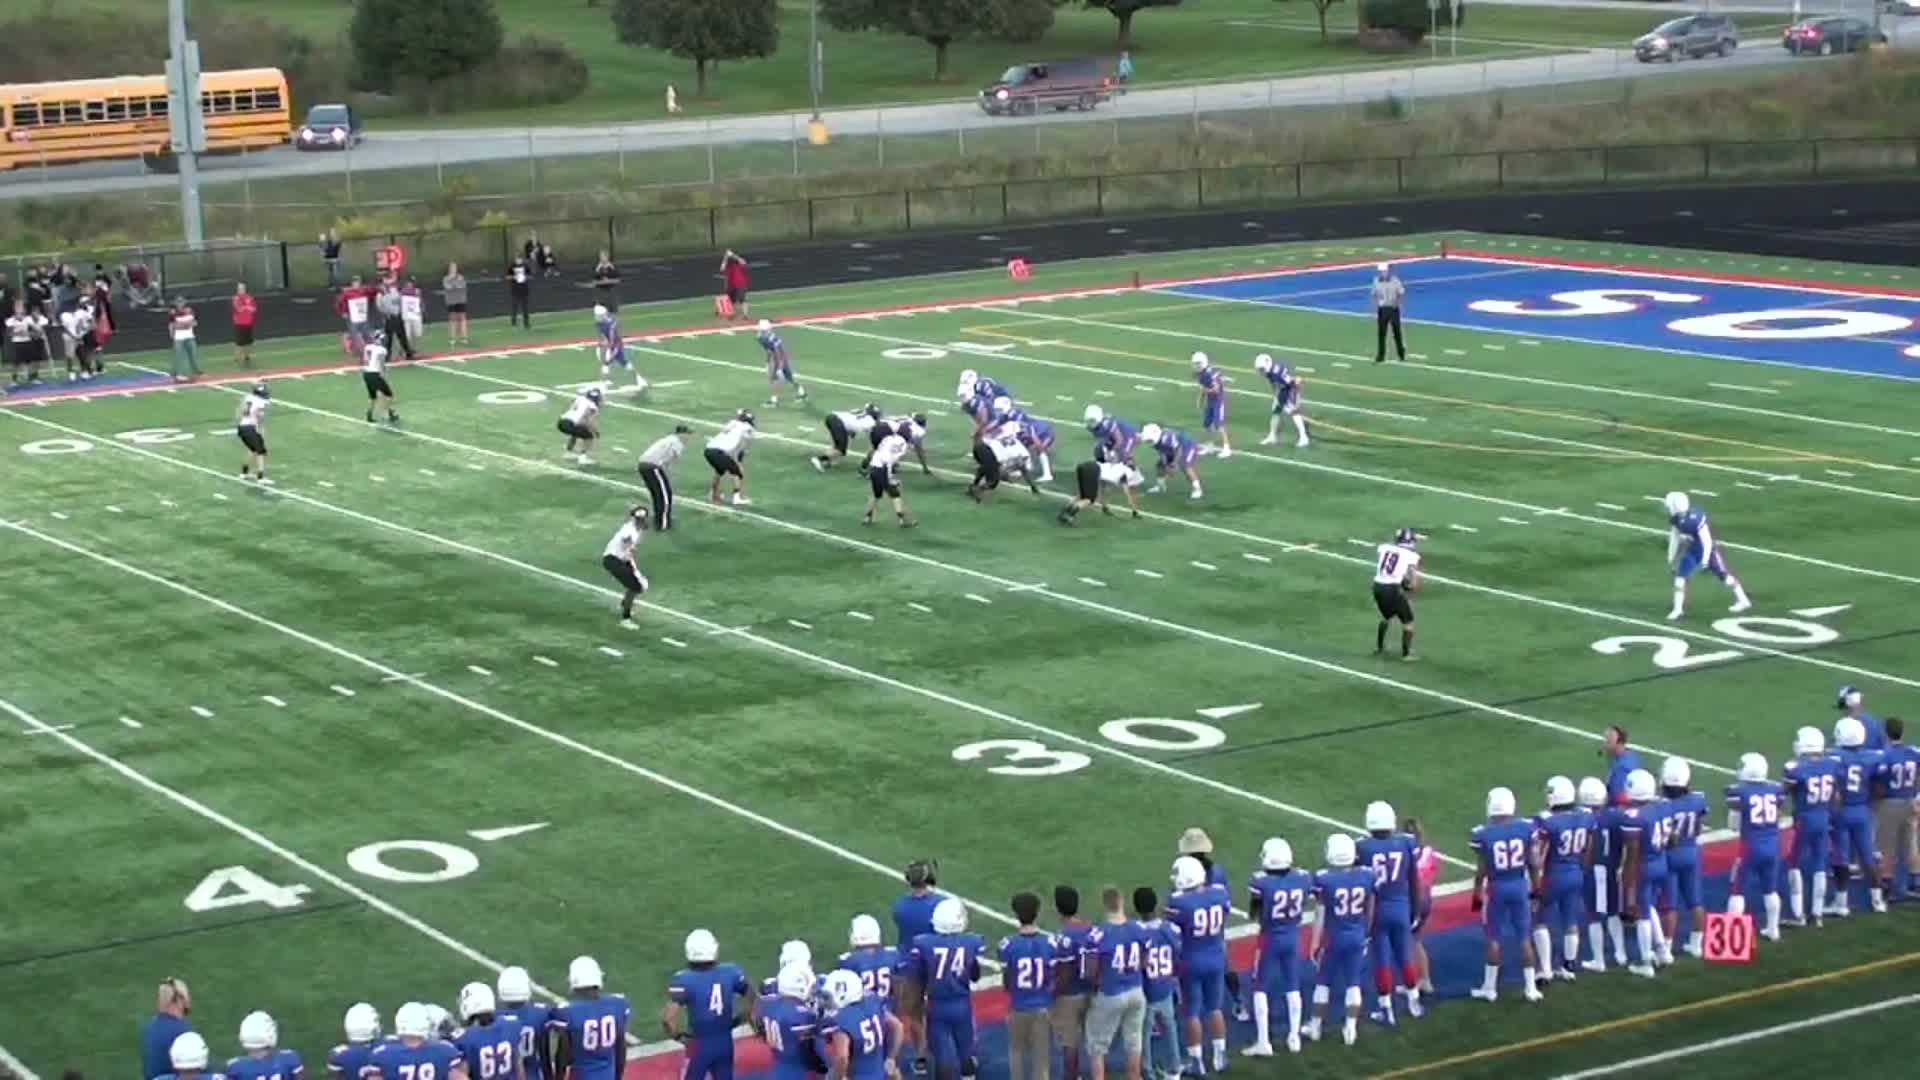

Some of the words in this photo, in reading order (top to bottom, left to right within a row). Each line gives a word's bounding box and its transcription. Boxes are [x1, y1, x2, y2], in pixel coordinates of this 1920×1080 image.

[1807, 774, 1834, 804] 56
[1847, 765, 1862, 792] 5
[1749, 794, 1777, 824] 26
[1493, 838, 1525, 870] 62
[1557, 827, 1587, 855] 30
[1271, 888, 1303, 919] 23
[1334, 886, 1365, 916] 32
[1193, 904, 1223, 937] 90
[1710, 916, 1746, 956] 30
[933, 946, 966, 980] 74
[1017, 957, 1044, 989] 21
[1111, 941, 1140, 975] 44
[862, 966, 891, 998] 25
[709, 982, 724, 1017] 4
[583, 1015, 616, 1050] 60
[859, 1014, 884, 1054] 51
[479, 1040, 513, 1079] 63
